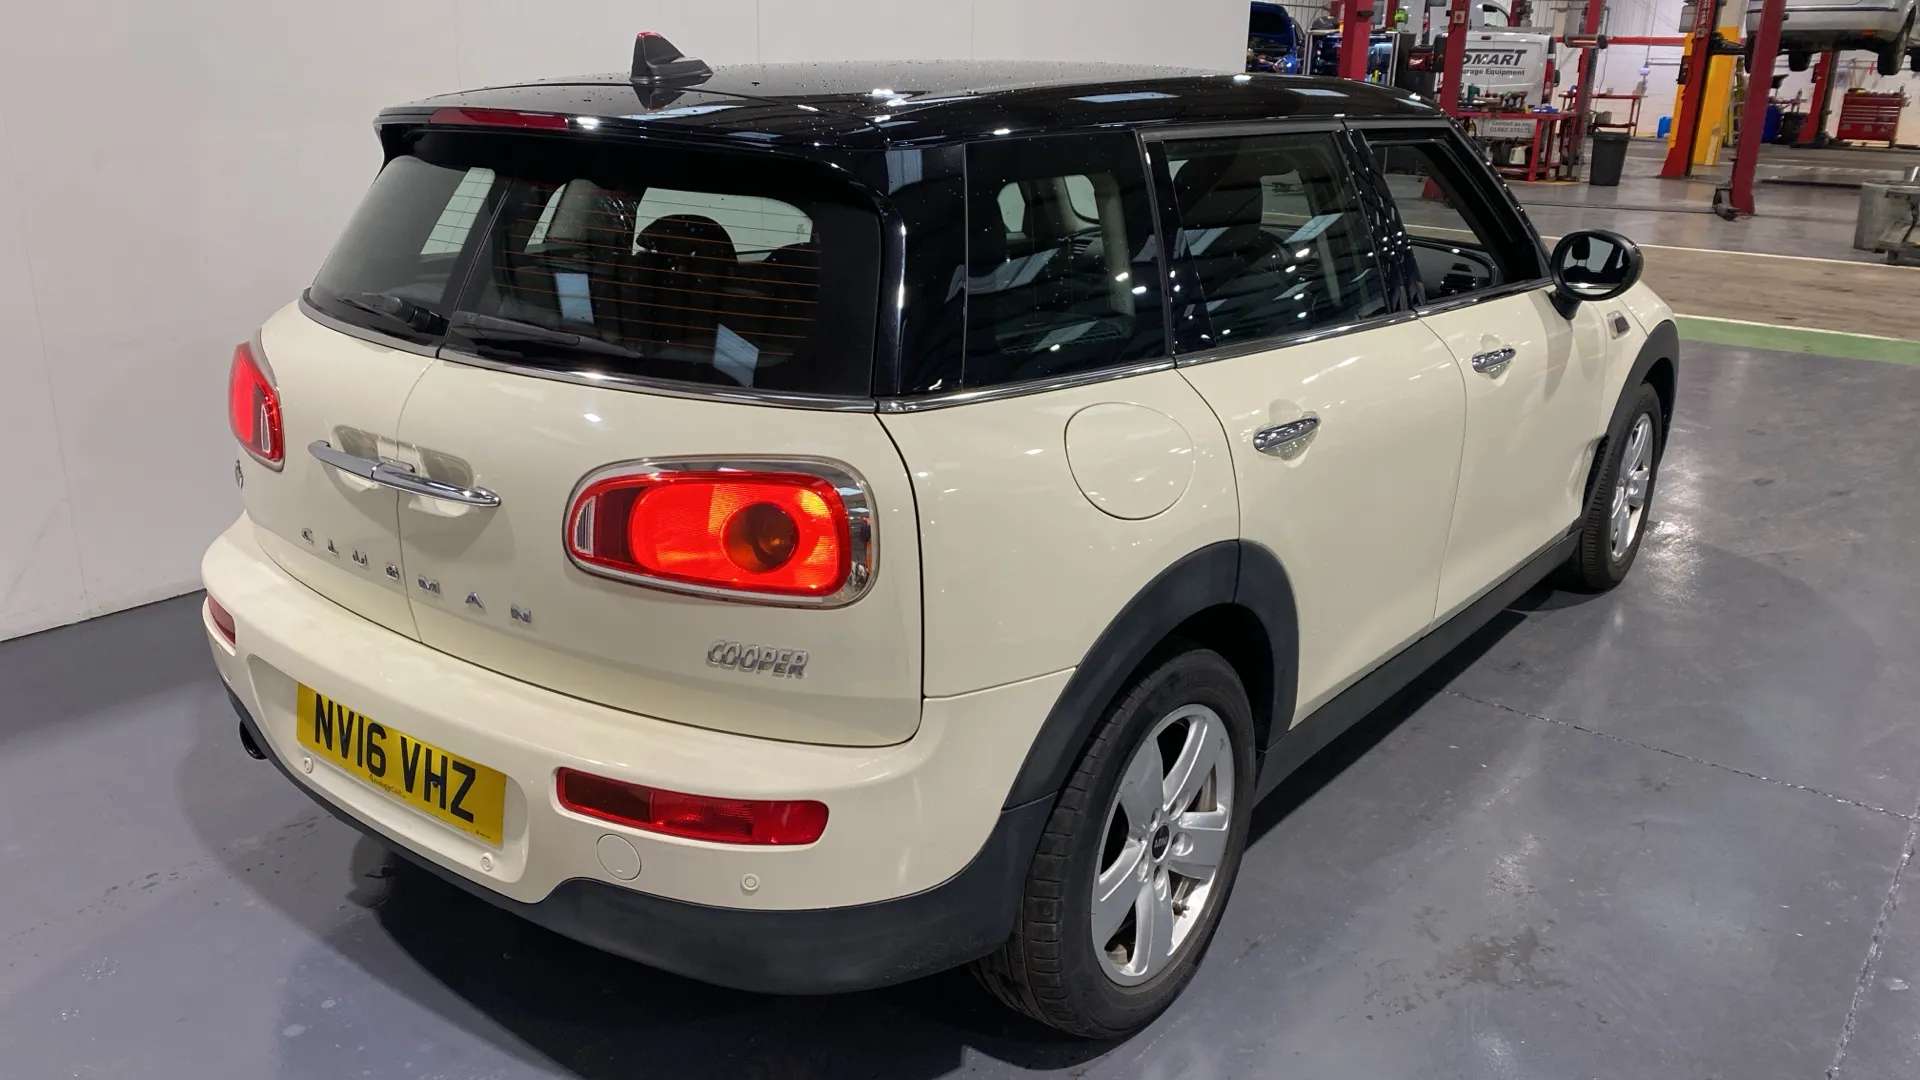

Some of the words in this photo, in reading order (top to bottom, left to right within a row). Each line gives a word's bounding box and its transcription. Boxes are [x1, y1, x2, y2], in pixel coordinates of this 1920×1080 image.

[302, 527, 532, 623] CLUBMAN
[707, 639, 808, 678] COOPER
[315, 692, 387, 778] NV16
[400, 736, 476, 823] VHZ
